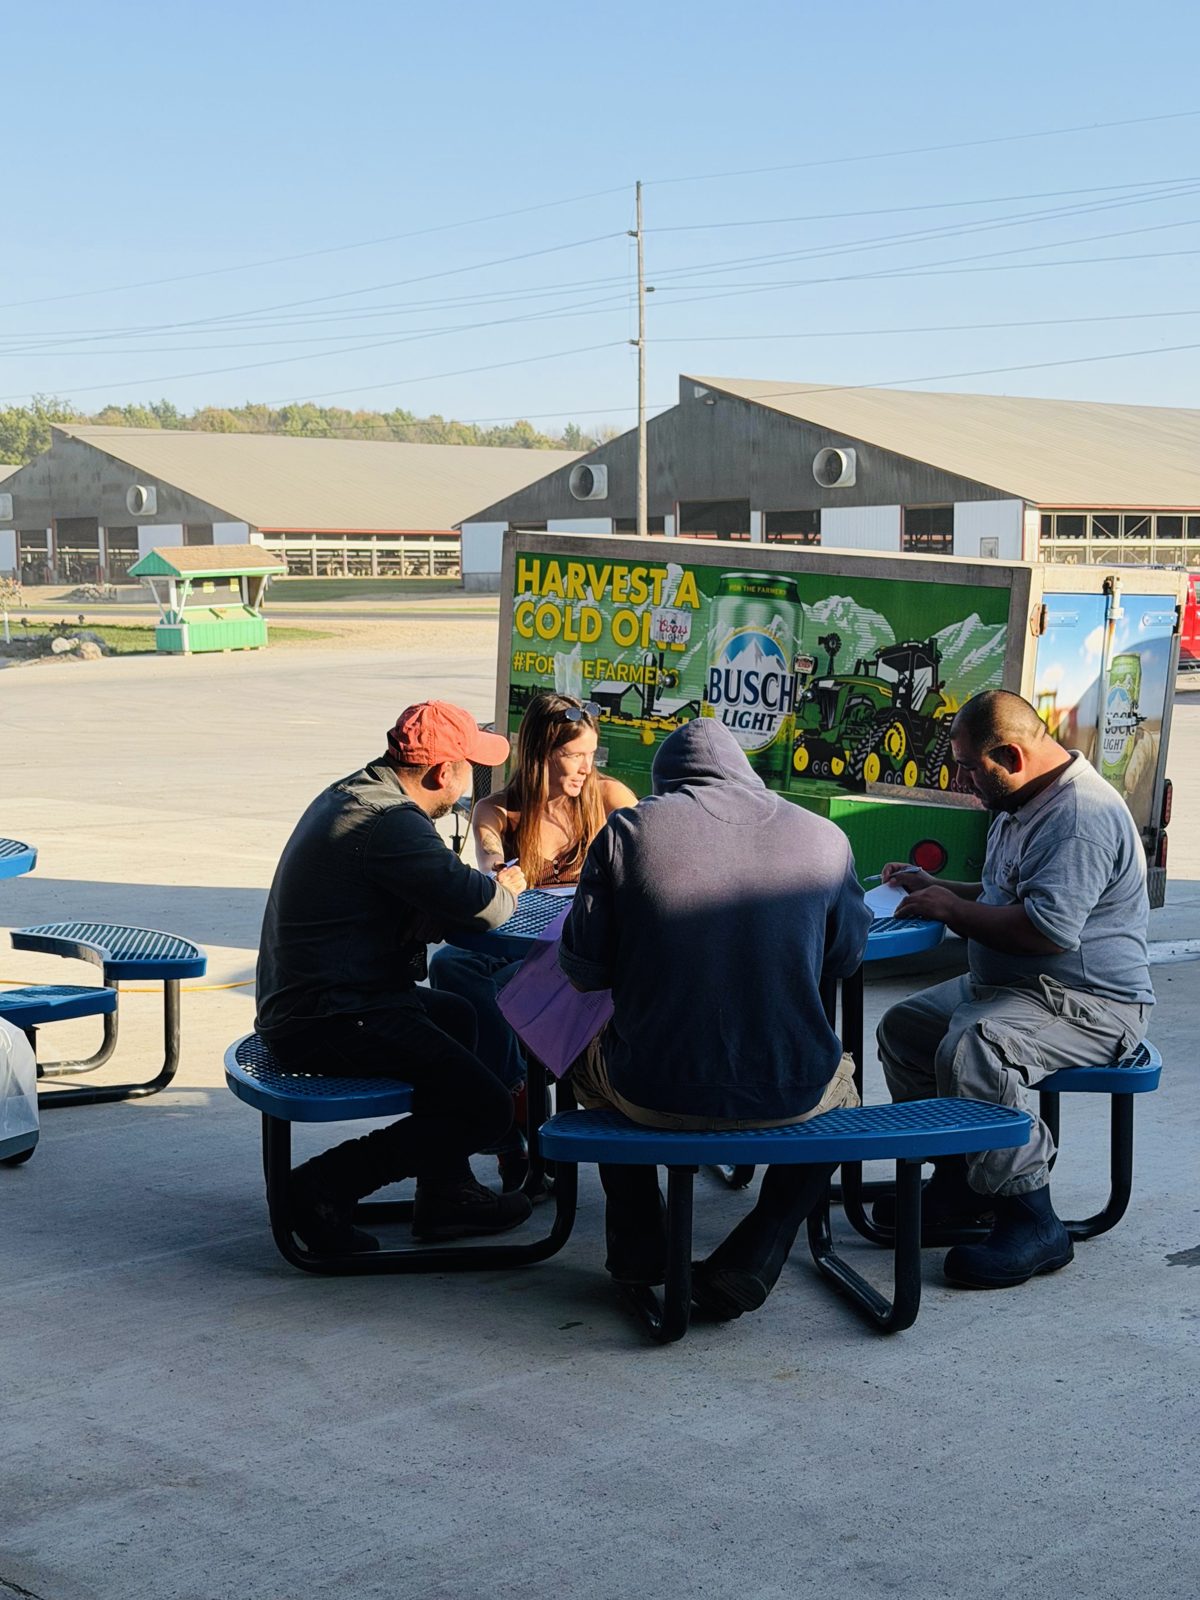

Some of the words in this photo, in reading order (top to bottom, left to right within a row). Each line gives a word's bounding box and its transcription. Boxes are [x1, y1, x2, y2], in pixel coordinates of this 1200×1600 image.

[517, 558, 668, 607] HARVEST
[674, 571, 700, 609] A
[515, 601, 602, 643] COLD
[611, 609, 687, 651] ON
[657, 618, 688, 635] Coors
[659, 632, 685, 641] LIGHT
[708, 667, 795, 713] BUSCH
[722, 709, 777, 731] LIGHT
[1103, 738, 1125, 751] LIGHT
